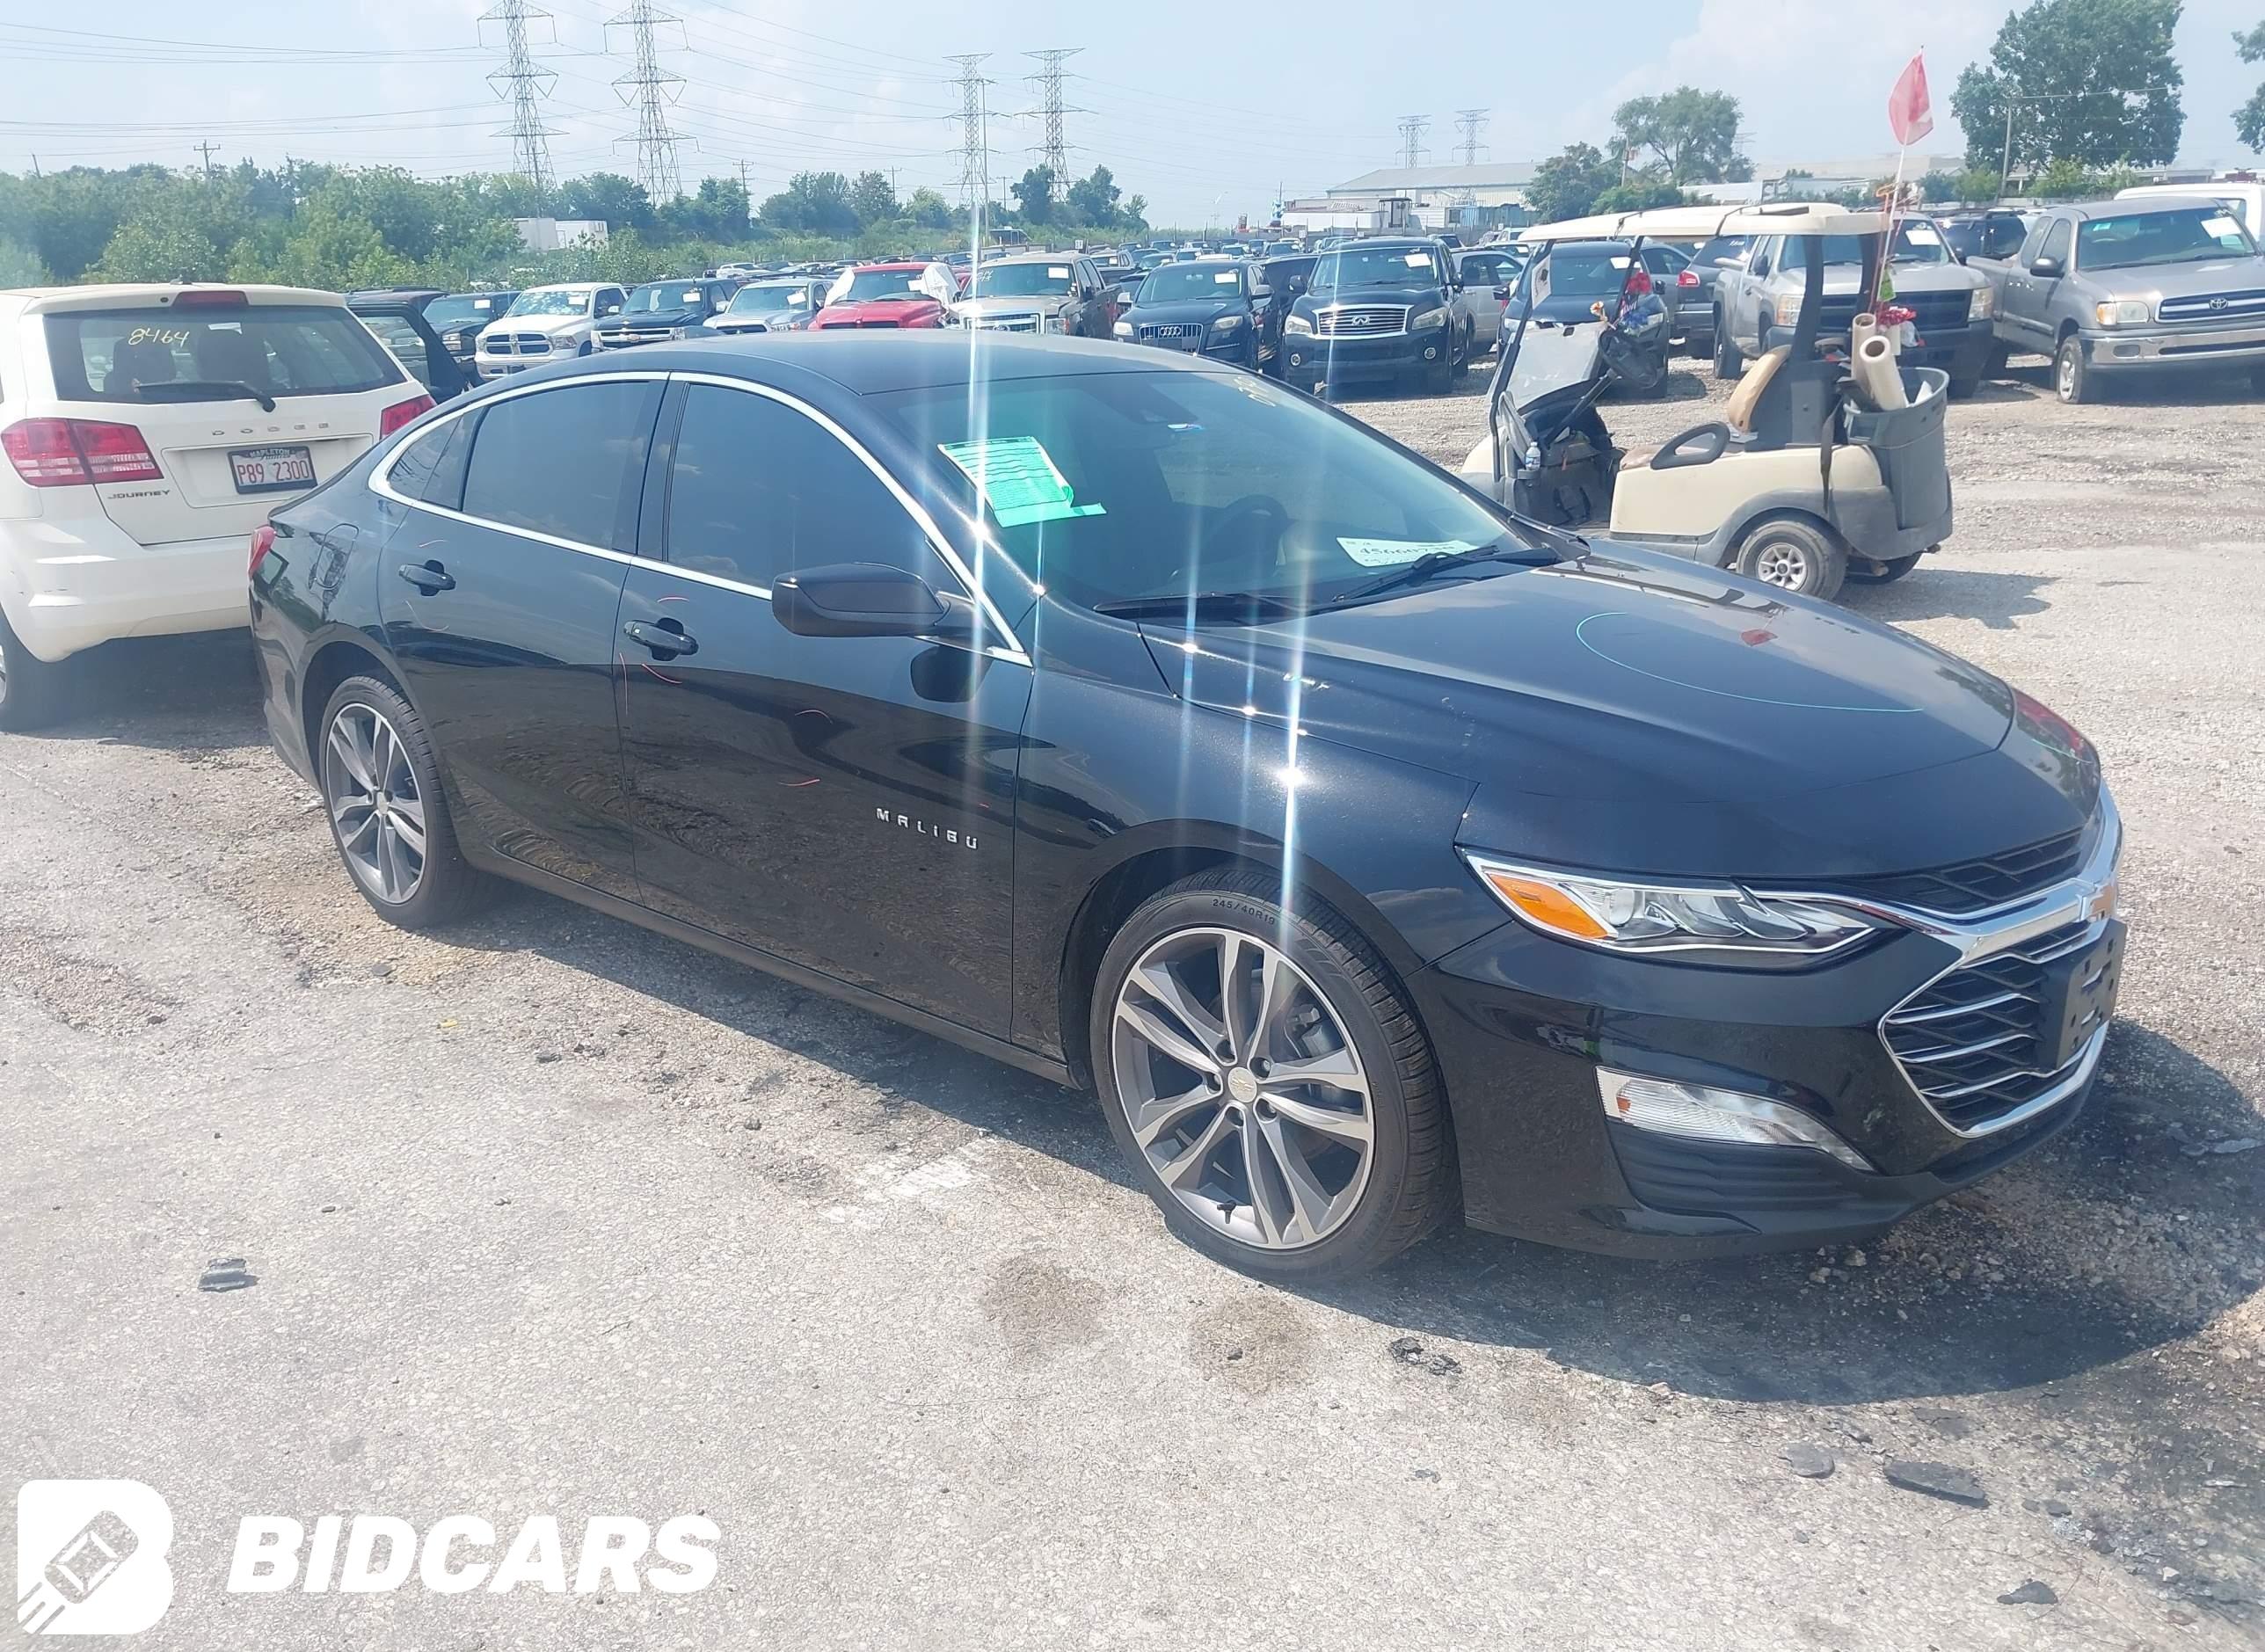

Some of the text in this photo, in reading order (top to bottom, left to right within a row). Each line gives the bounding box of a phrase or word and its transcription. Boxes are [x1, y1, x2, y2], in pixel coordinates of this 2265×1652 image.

[128, 327, 190, 347] 8464
[237, 460, 310, 484] P89 2300
[108, 489, 171, 499] JOURNEY
[876, 807, 977, 849] MALIBU
[1213, 899, 1275, 925] 245/40R19
